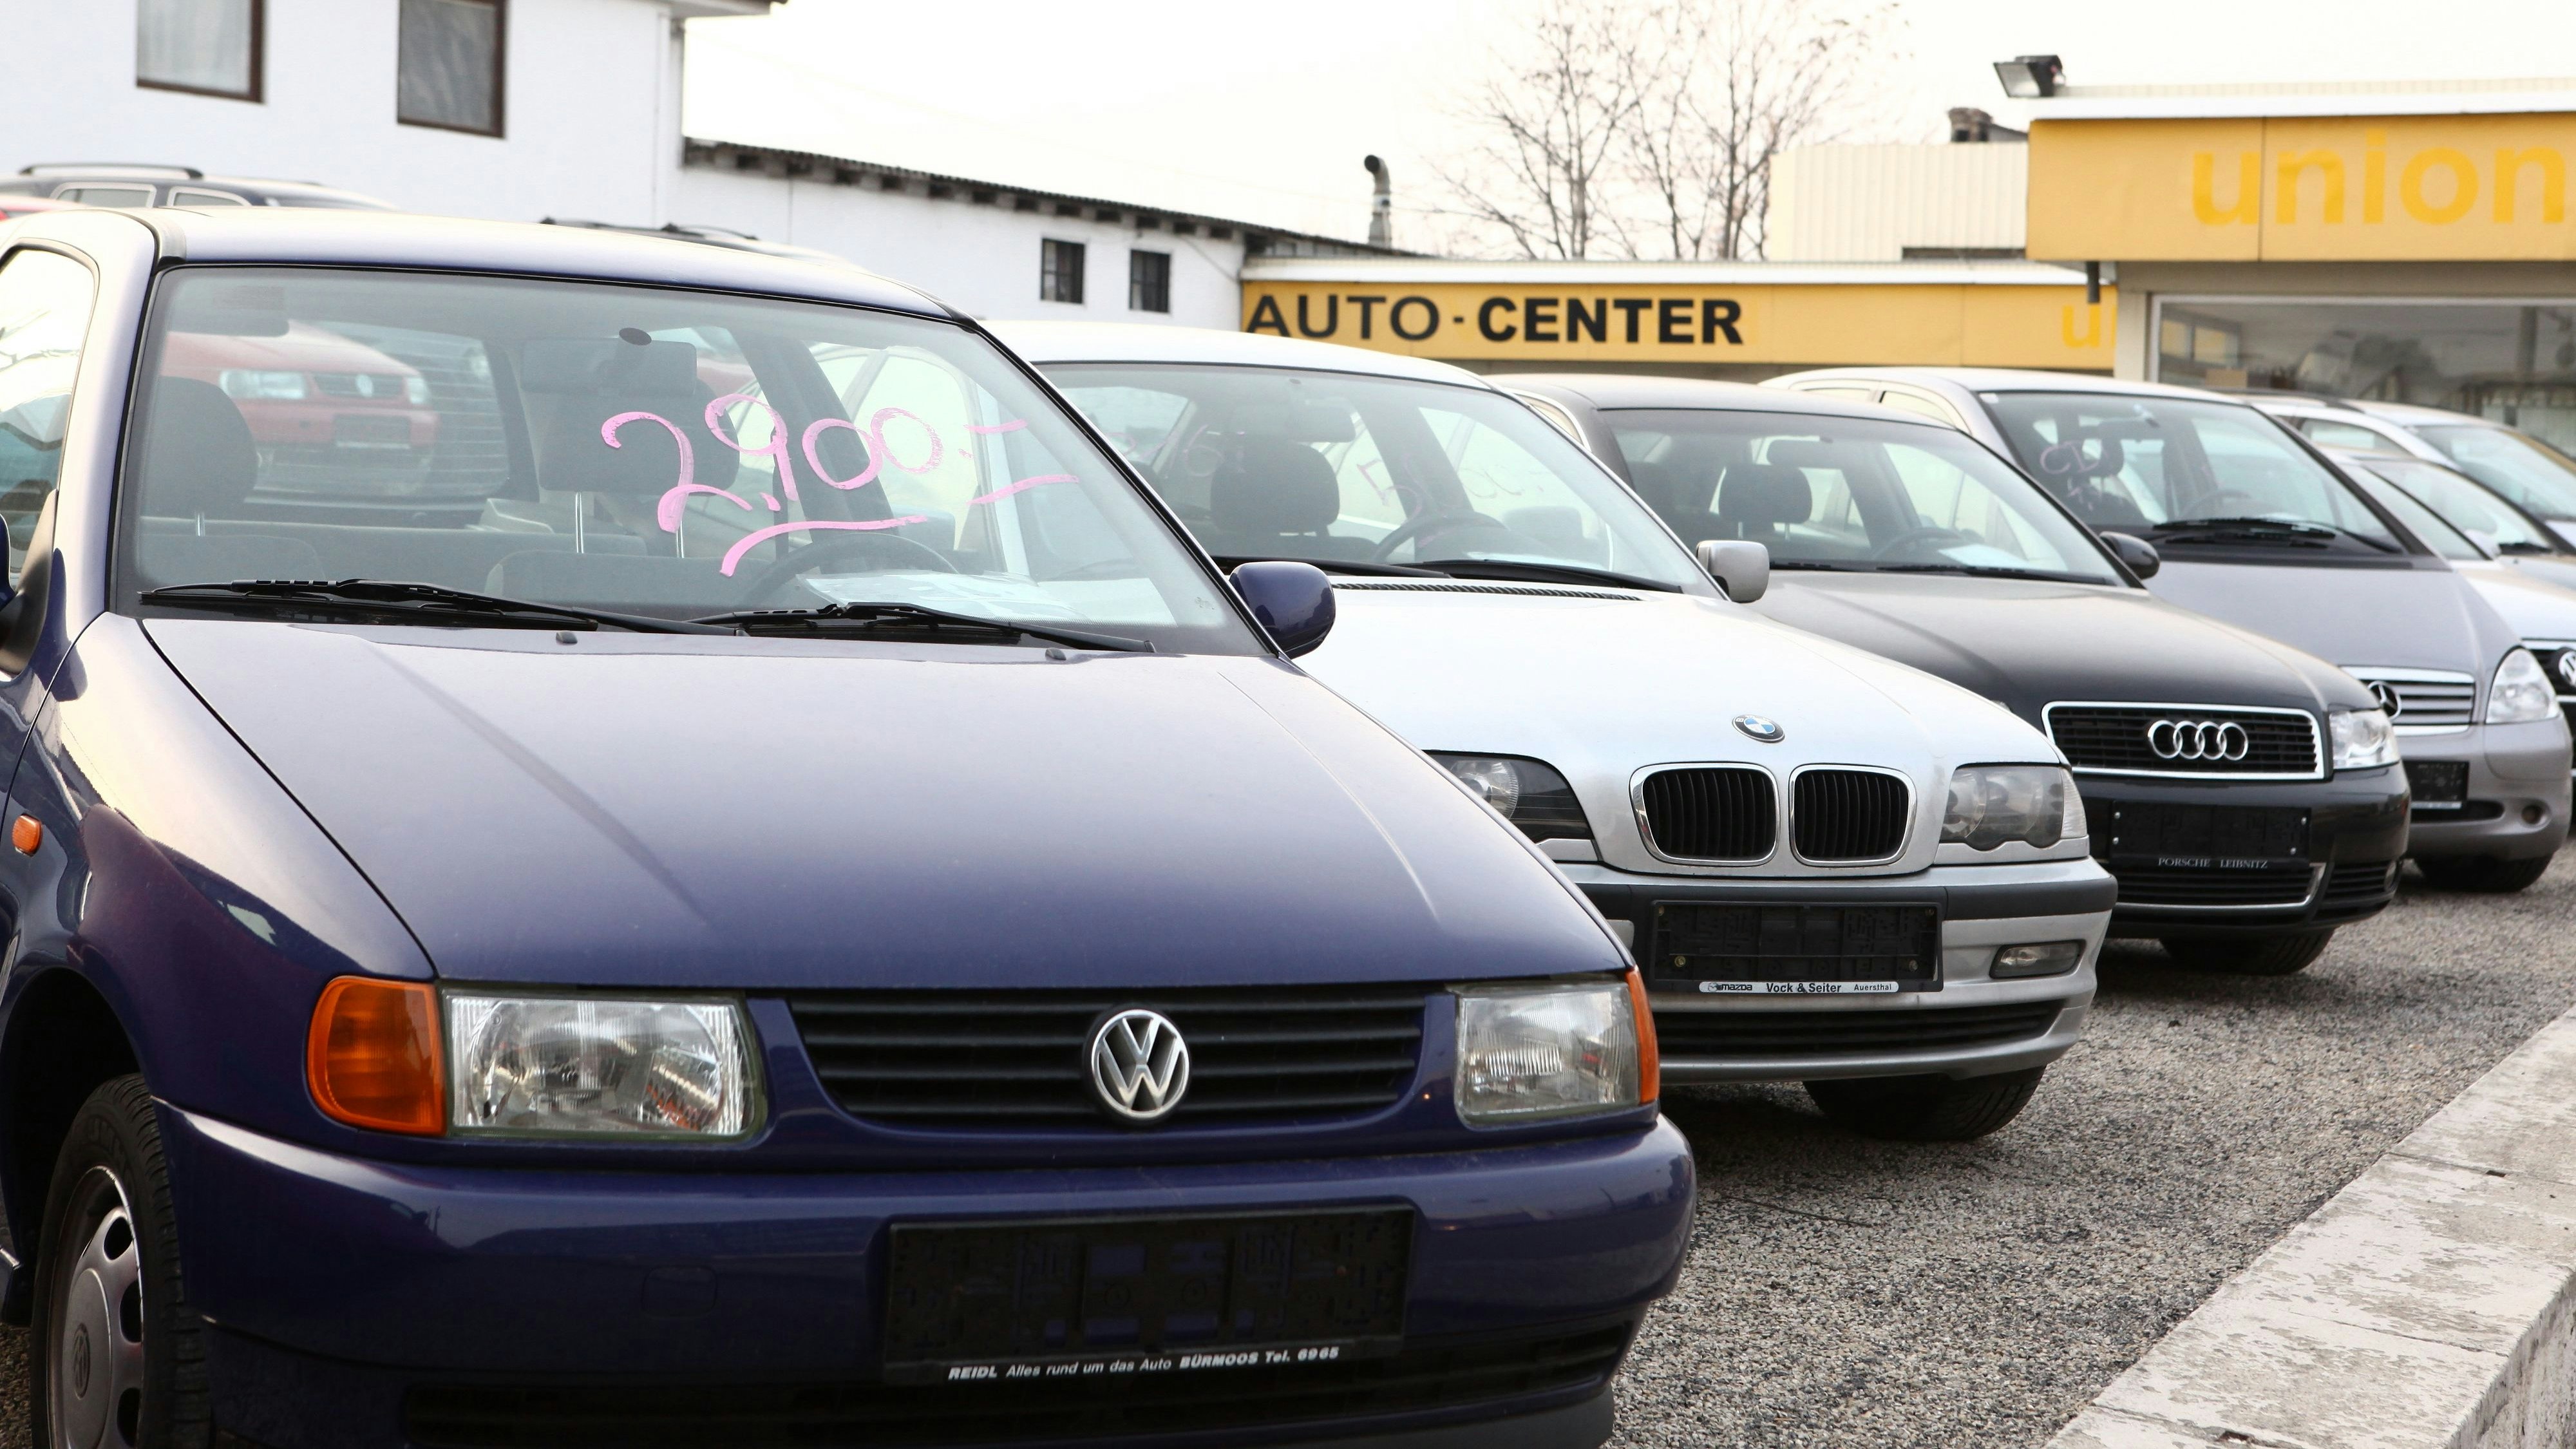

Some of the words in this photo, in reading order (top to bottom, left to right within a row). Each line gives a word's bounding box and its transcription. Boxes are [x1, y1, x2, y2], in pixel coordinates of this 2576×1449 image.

[2192, 129, 2566, 225] union
[2158, 857, 2210, 867] PORSCHE
[2220, 859, 2268, 869] LEIBNITZ
[1766, 983, 1795, 993] Vock
[1797, 983, 1808, 994] &
[1808, 982, 1842, 994] Seiter
[1853, 983, 1892, 992] Auersthal
[948, 1366, 998, 1380] REIDL
[1006, 1364, 1041, 1377] Alles
[1046, 1361, 1079, 1376] rund
[1083, 1363, 1104, 1374] um
[1110, 1359, 1134, 1372] das
[1140, 1359, 1172, 1370] Auto
[1179, 1351, 1259, 1368] BÜRMOOS
[1265, 1349, 1291, 1363] Tel.
